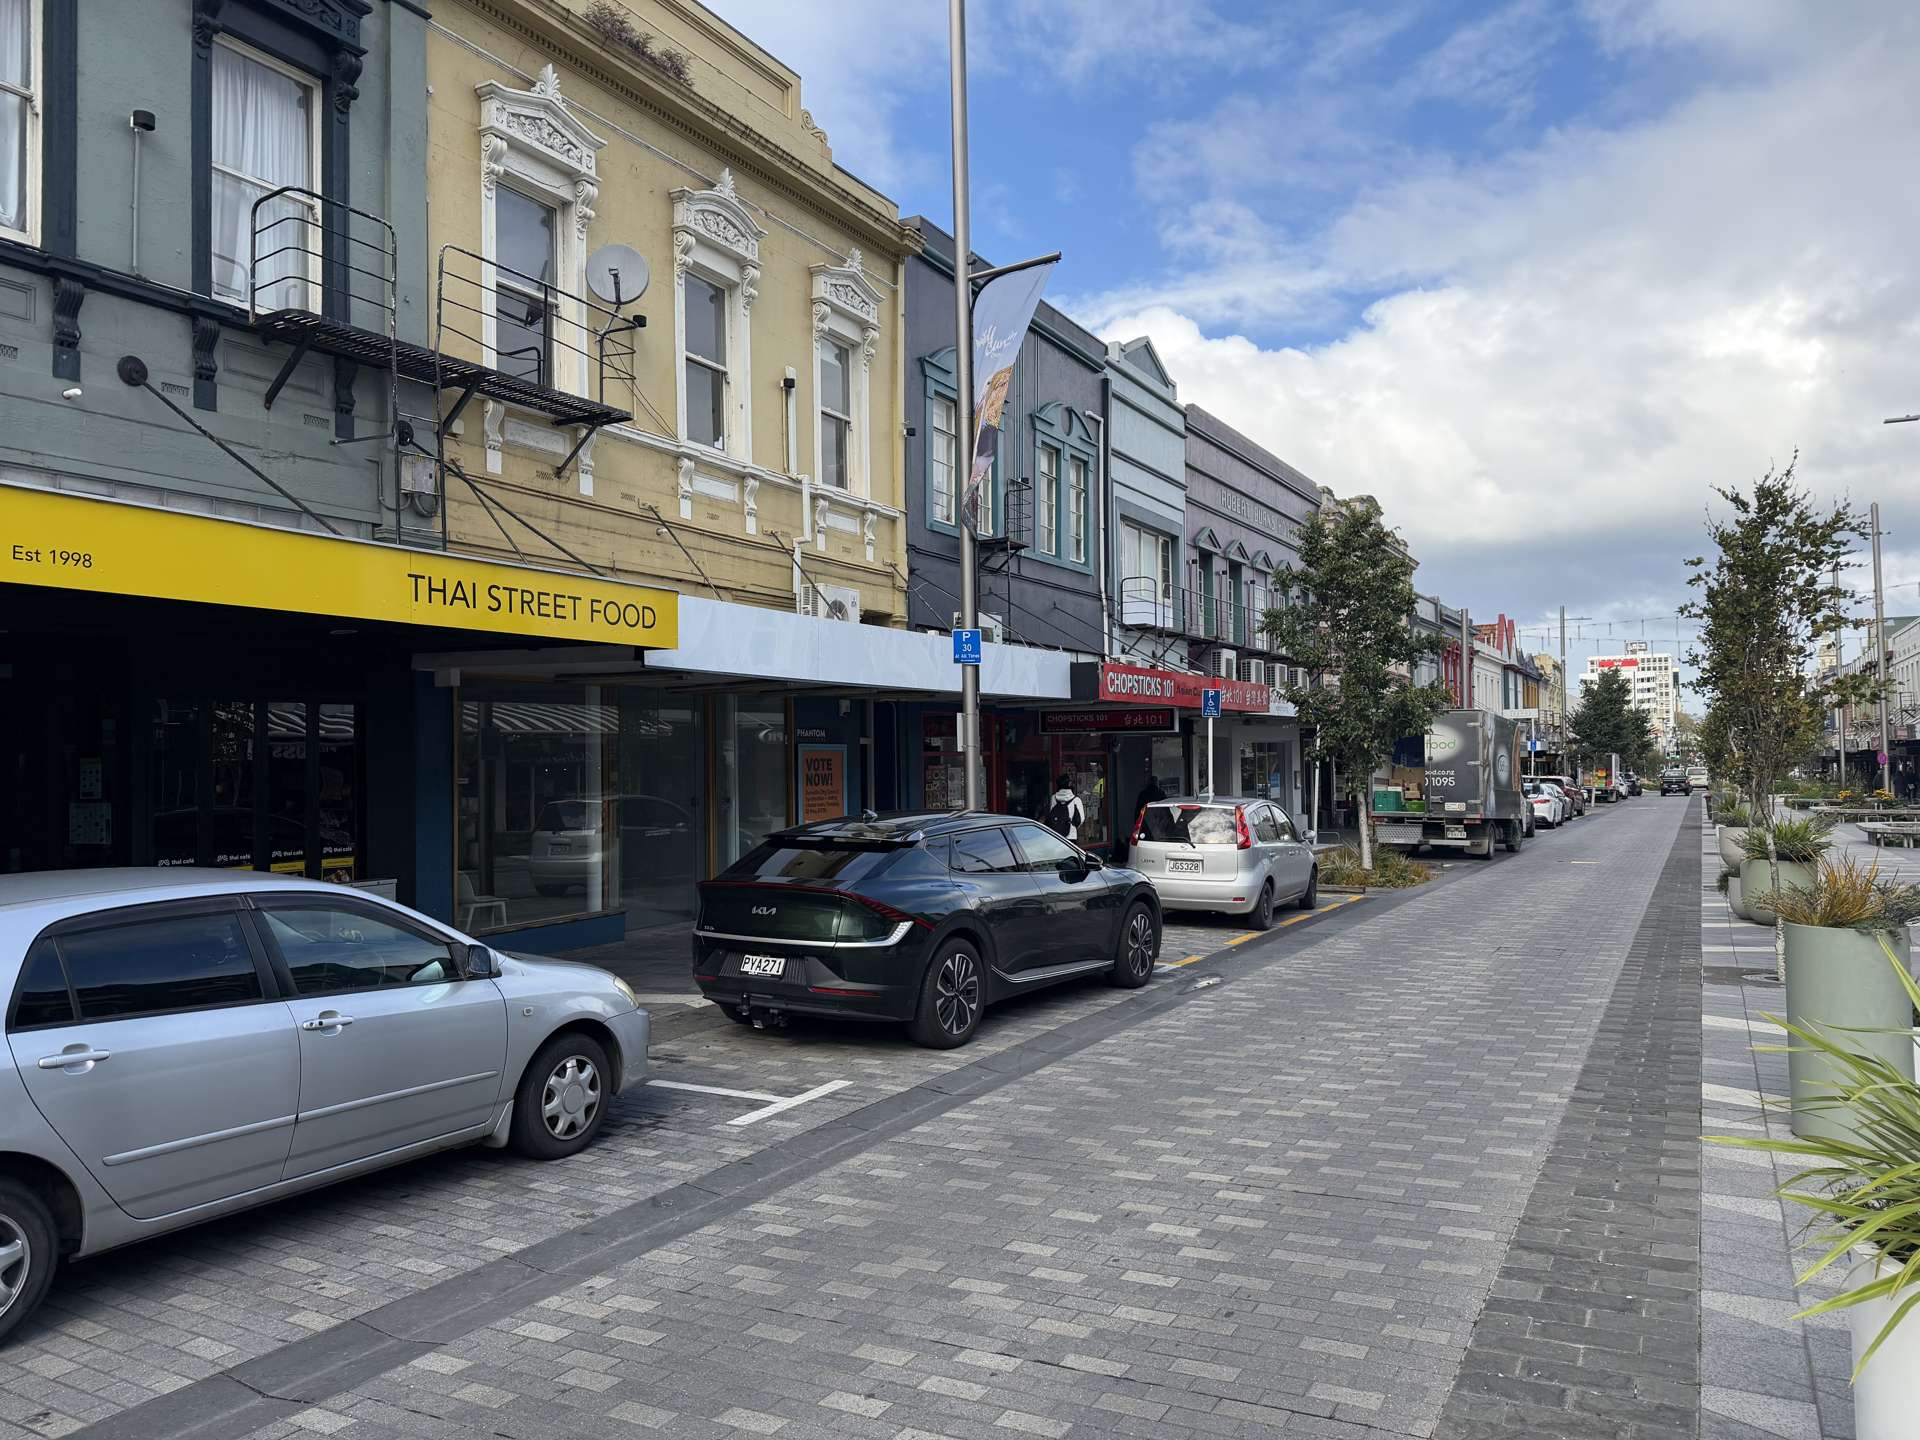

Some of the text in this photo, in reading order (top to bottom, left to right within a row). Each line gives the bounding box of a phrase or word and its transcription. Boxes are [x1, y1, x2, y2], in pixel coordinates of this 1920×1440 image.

[1221, 489, 1249, 518] ROBERT
[1255, 507, 1275, 530] BURNS
[12, 545, 93, 569] Est 1998
[407, 573, 656, 629] THAI STREET FOOD
[962, 631, 971, 642] P
[962, 643, 972, 652] 30
[1107, 671, 1162, 698] CHOPSTICKS
[1163, 679, 1175, 698] 101
[1208, 690, 1215, 698] P
[1047, 711, 1108, 723] CHOPSTICKS 101
[797, 729, 826, 737] PHANTOM
[806, 759, 832, 771] VOTE
[806, 772, 832, 786] NOW!
[1431, 777, 1456, 787] 1095
[742, 957, 781, 973] PYA271
